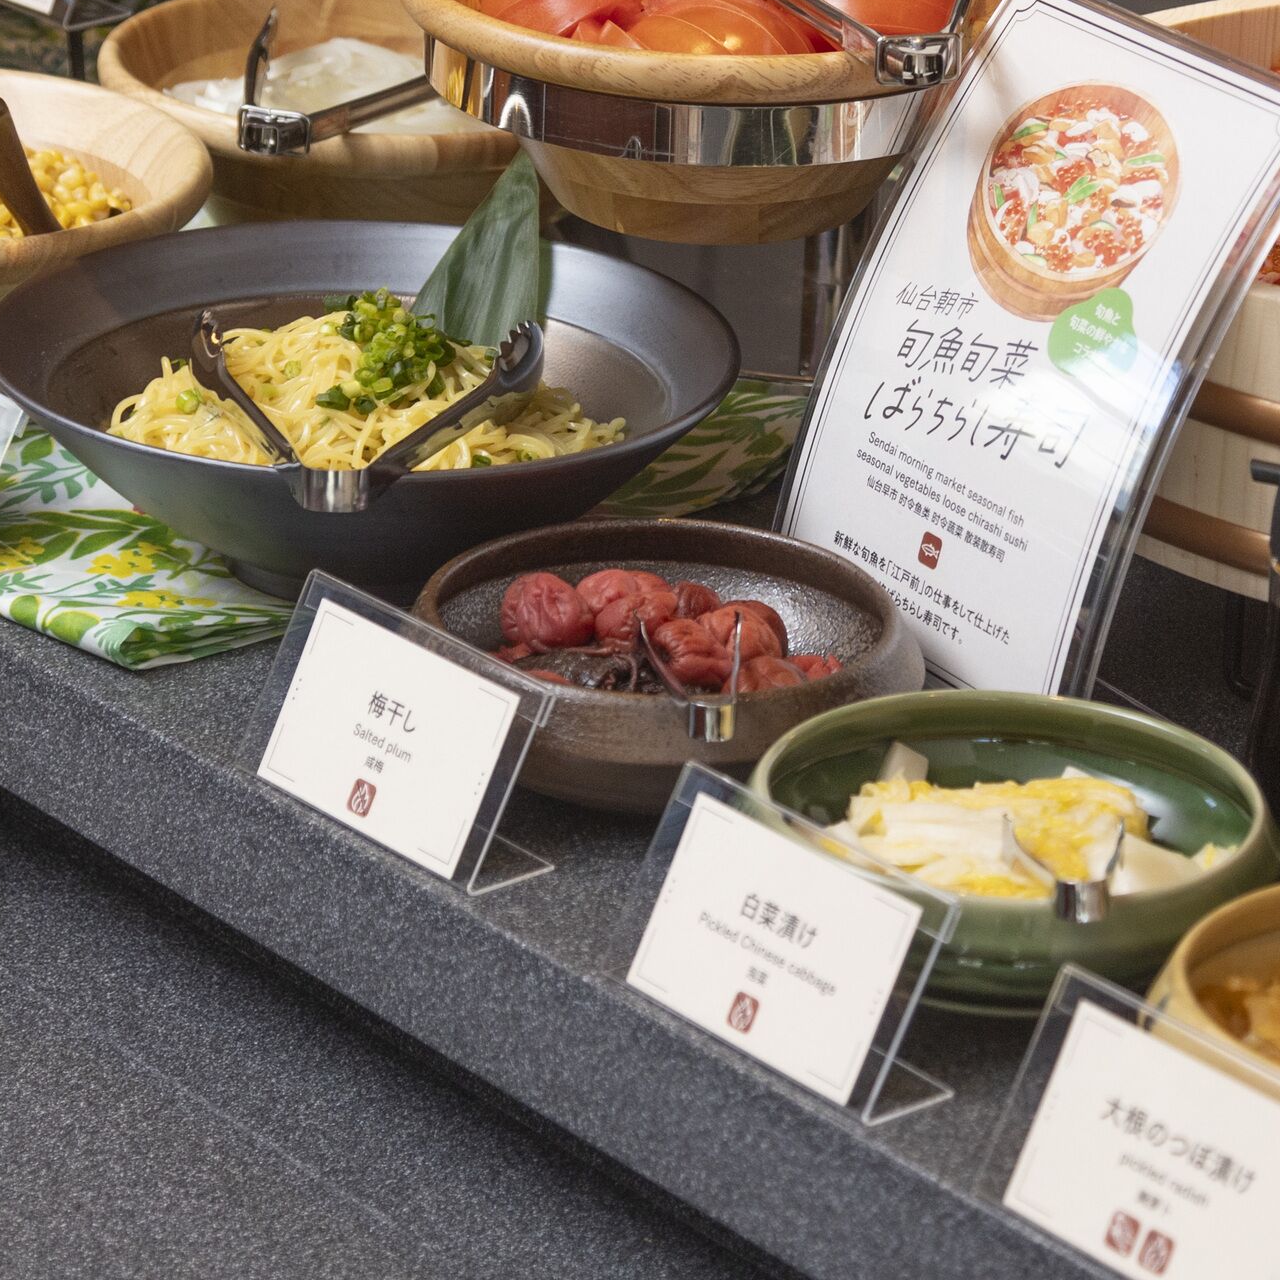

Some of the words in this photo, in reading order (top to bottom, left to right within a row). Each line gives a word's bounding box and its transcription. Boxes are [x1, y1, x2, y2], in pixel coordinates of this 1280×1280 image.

[895, 281, 980, 320] 仙台朝市
[1069, 314, 1121, 351] 旬菜の鮮や
[896, 318, 1039, 390] 旬魚旬菜
[863, 376, 1090, 470] ばらちらし寿司
[856, 448, 894, 476] seasonal
[894, 468, 941, 504] vegetables
[942, 496, 966, 518] loose
[967, 510, 1003, 540] chirashi
[1003, 531, 1029, 552] sushi
[866, 475, 898, 502] 仙台早市
[898, 492, 930, 520] 时令鱼类
[930, 512, 964, 540] 时令蔬菜
[963, 529, 1006, 564] 散装散寿司
[868, 431, 898, 458] Sendai
[898, 450, 934, 480] morning
[934, 470, 966, 496] market
[966, 489, 1006, 518] seasonal
[1006, 508, 1024, 528] fish
[832, 529, 1010, 646] 新鮮な旬魚を「江戸前」の仕事をして仕上げた
[353, 723, 385, 749] Salted
[385, 741, 412, 764] plum
[367, 690, 417, 733] 梅干し
[697, 910, 741, 944] Pickled
[740, 934, 787, 970] Chinese
[787, 961, 837, 997] cabbage
[739, 892, 820, 951] 白菜漬け
[1099, 1093, 1257, 1195] 大根のつぼ漬け
